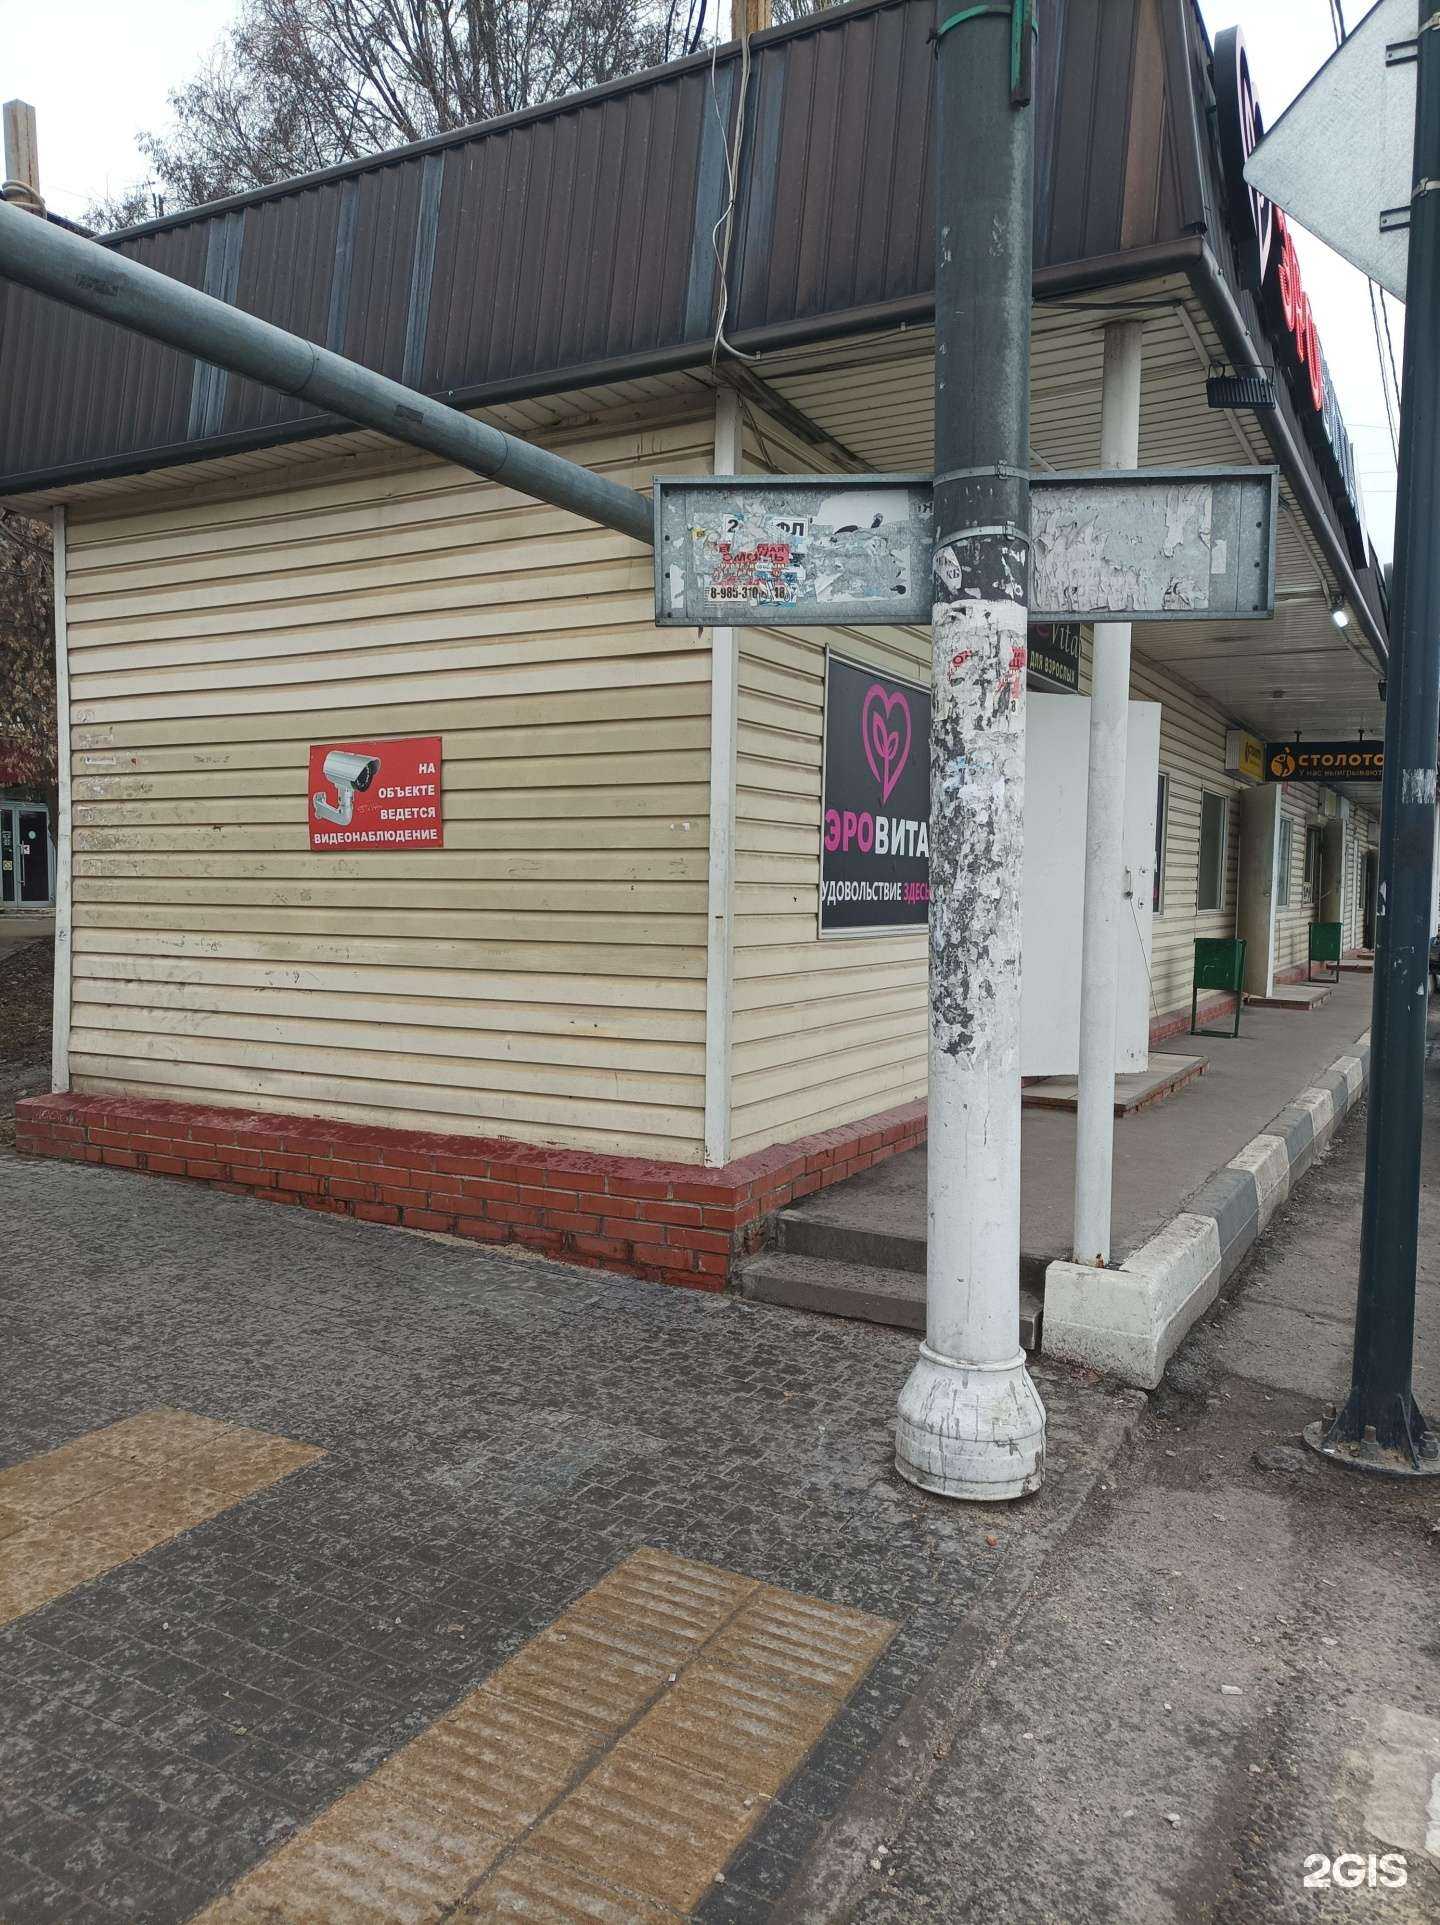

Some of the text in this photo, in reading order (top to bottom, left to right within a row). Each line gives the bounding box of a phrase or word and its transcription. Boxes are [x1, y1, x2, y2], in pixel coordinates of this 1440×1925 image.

[418, 763, 435, 774] НА
[378, 784, 436, 799] ОБЪЕКТЕ
[380, 807, 436, 821] ВЕДЕТСЯ
[314, 829, 438, 845] ВИДЕОНАБЛЮДЕНИЕ
[824, 808, 929, 858] ЭРОВИТА
[820, 880, 902, 906] УДОВОЛЬСТВИЕ
